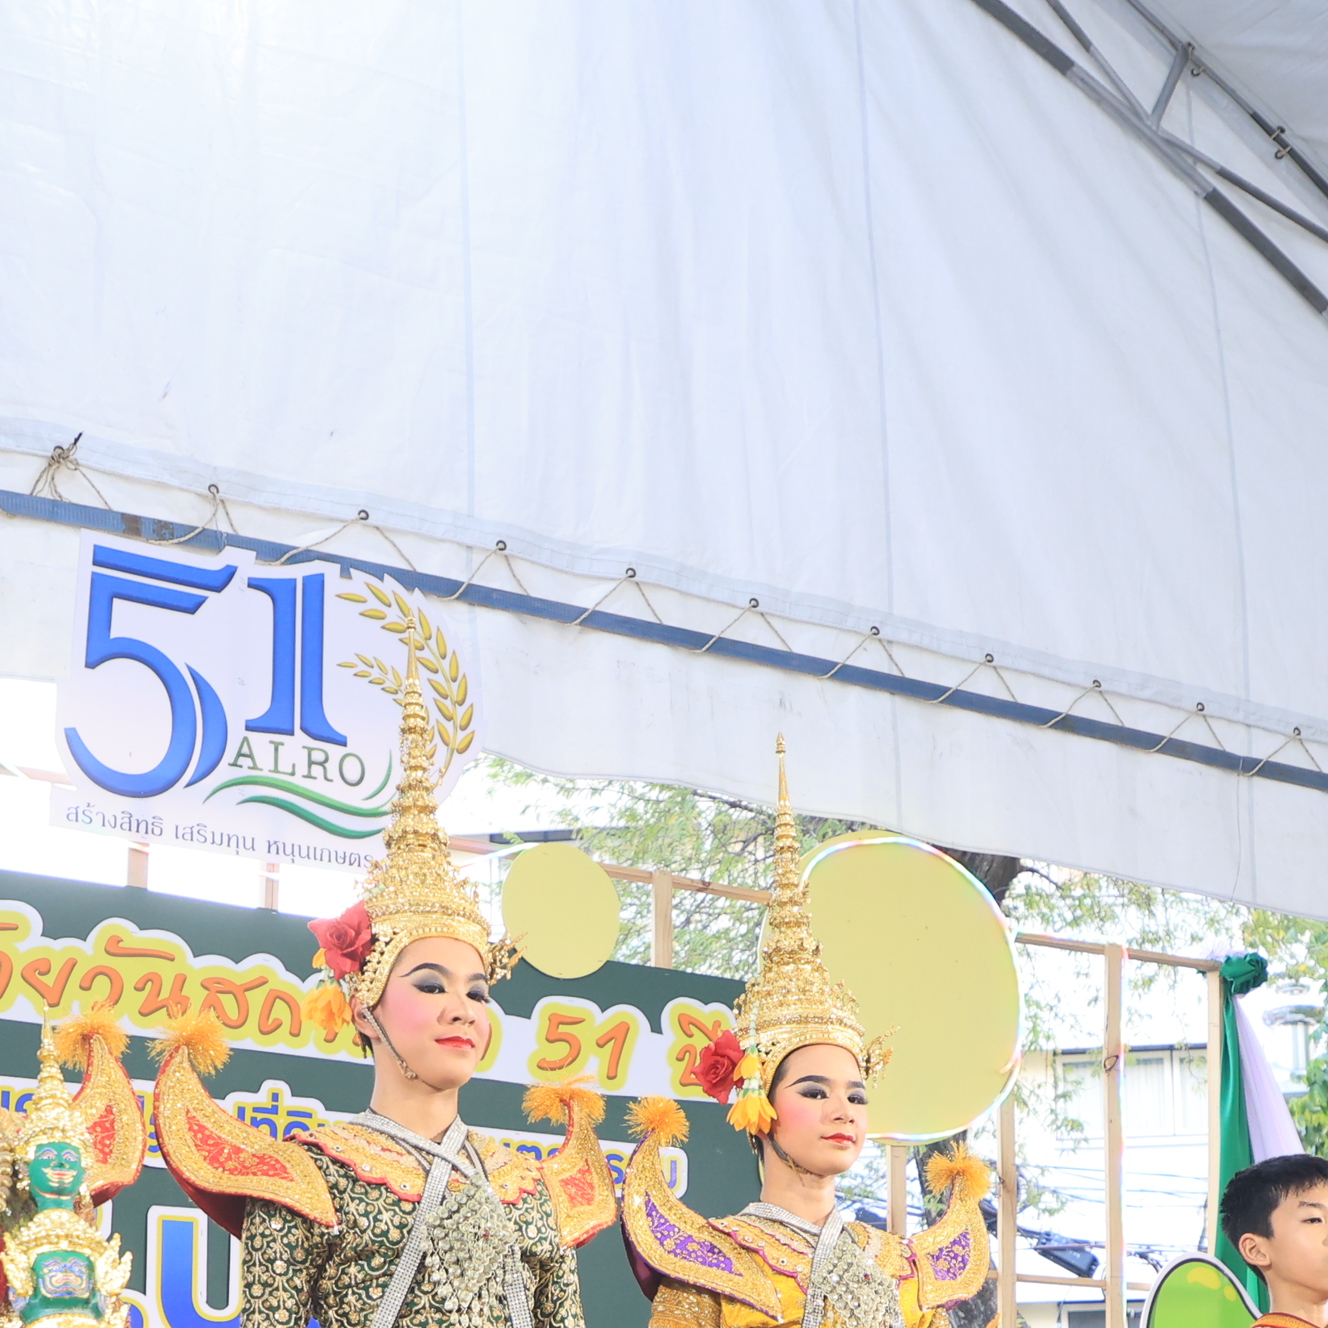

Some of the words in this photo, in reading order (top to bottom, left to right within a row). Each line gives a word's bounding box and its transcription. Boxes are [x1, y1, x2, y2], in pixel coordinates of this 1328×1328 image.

[63, 543, 348, 799] 51
[227, 735, 366, 787] ALRO
[66, 802, 164, 837] สร้างสิทธิ
[174, 822, 257, 855] เสริมทุน
[266, 838, 375, 869] หนุนเกษตร
[536, 1012, 631, 1081] 51
